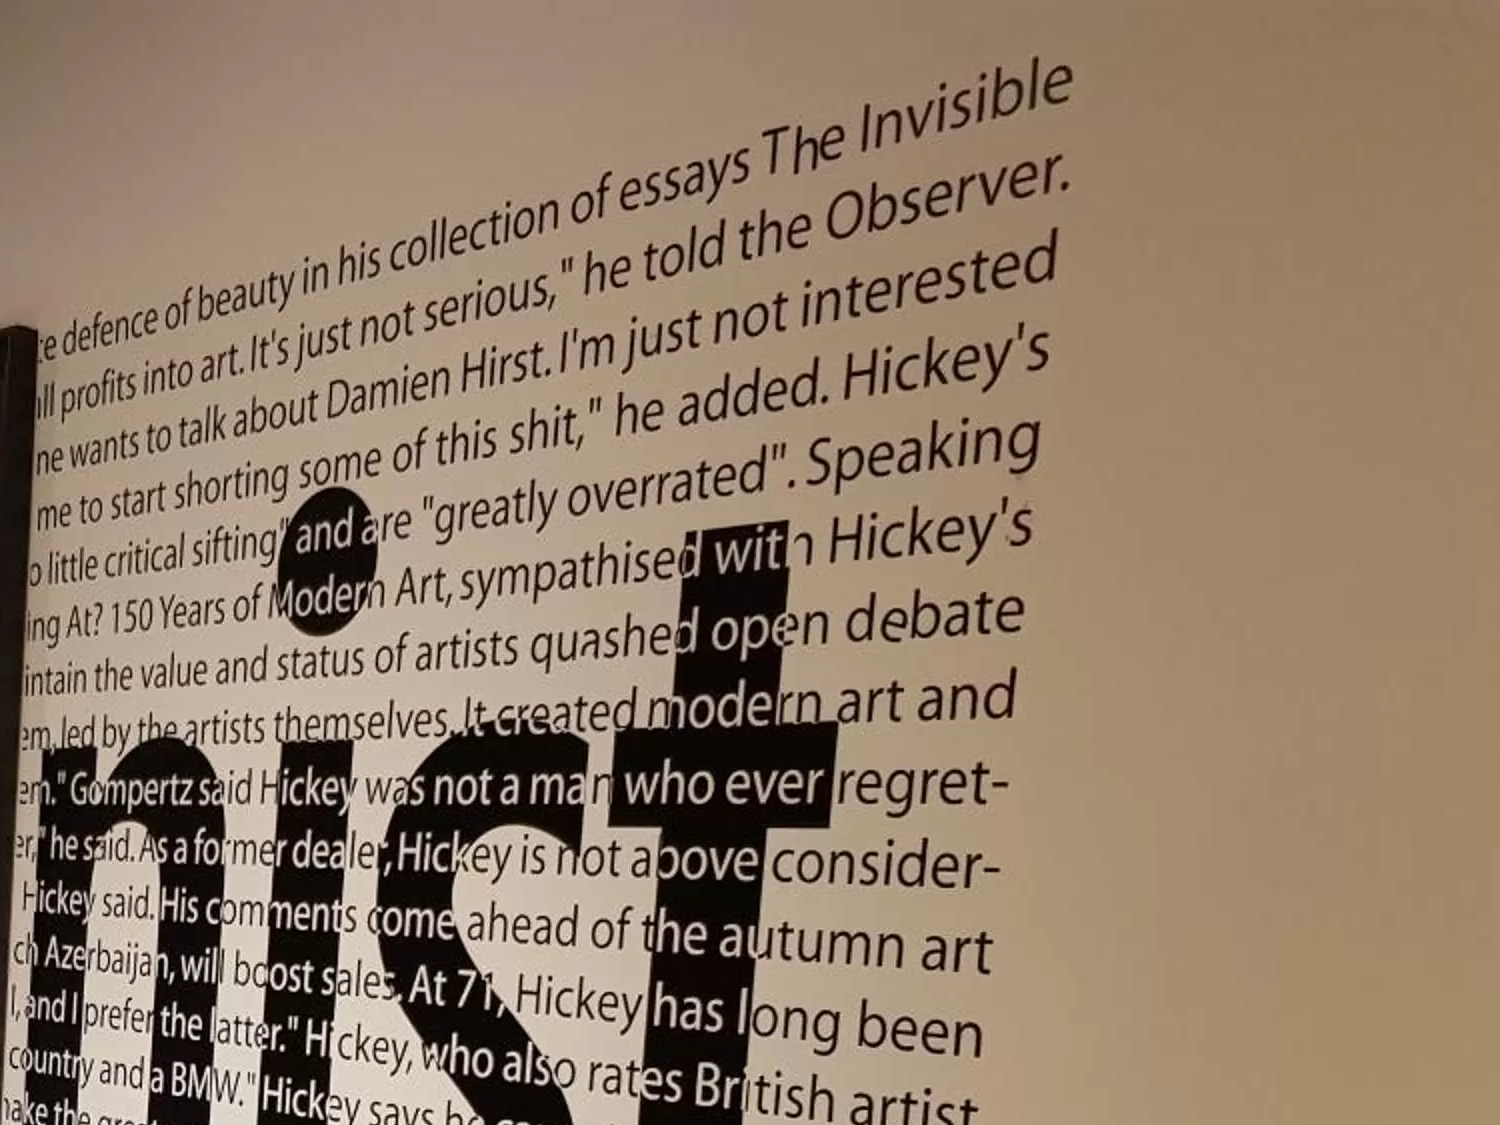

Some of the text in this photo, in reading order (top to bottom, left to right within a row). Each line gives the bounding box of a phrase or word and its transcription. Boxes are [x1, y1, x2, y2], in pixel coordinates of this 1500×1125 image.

[62, 53, 1075, 356] defence of beauty in his collection of essays The Invisible
[60, 153, 1070, 423] profits into art. It's just not serious," he told the Observer.
[68, 225, 1059, 469] wants to talk about Damien Hirst. I'm just not interested
[37, 321, 1051, 531] me to start shorting some of this shit," he added. Hickey's
[47, 545, 98, 584] little
[104, 530, 185, 577] critical
[295, 506, 354, 553] and
[423, 479, 557, 547] "greatly
[806, 416, 1041, 498] Speaking
[66, 496, 1034, 638] At? 150 Years of Art, Hickey's
[93, 587, 1026, 692] the value and status of artists open debate
[622, 759, 1008, 821] who regret-
[771, 837, 1000, 891] consider-
[718, 921, 905, 970] autumn
[858, 997, 984, 1059] been
